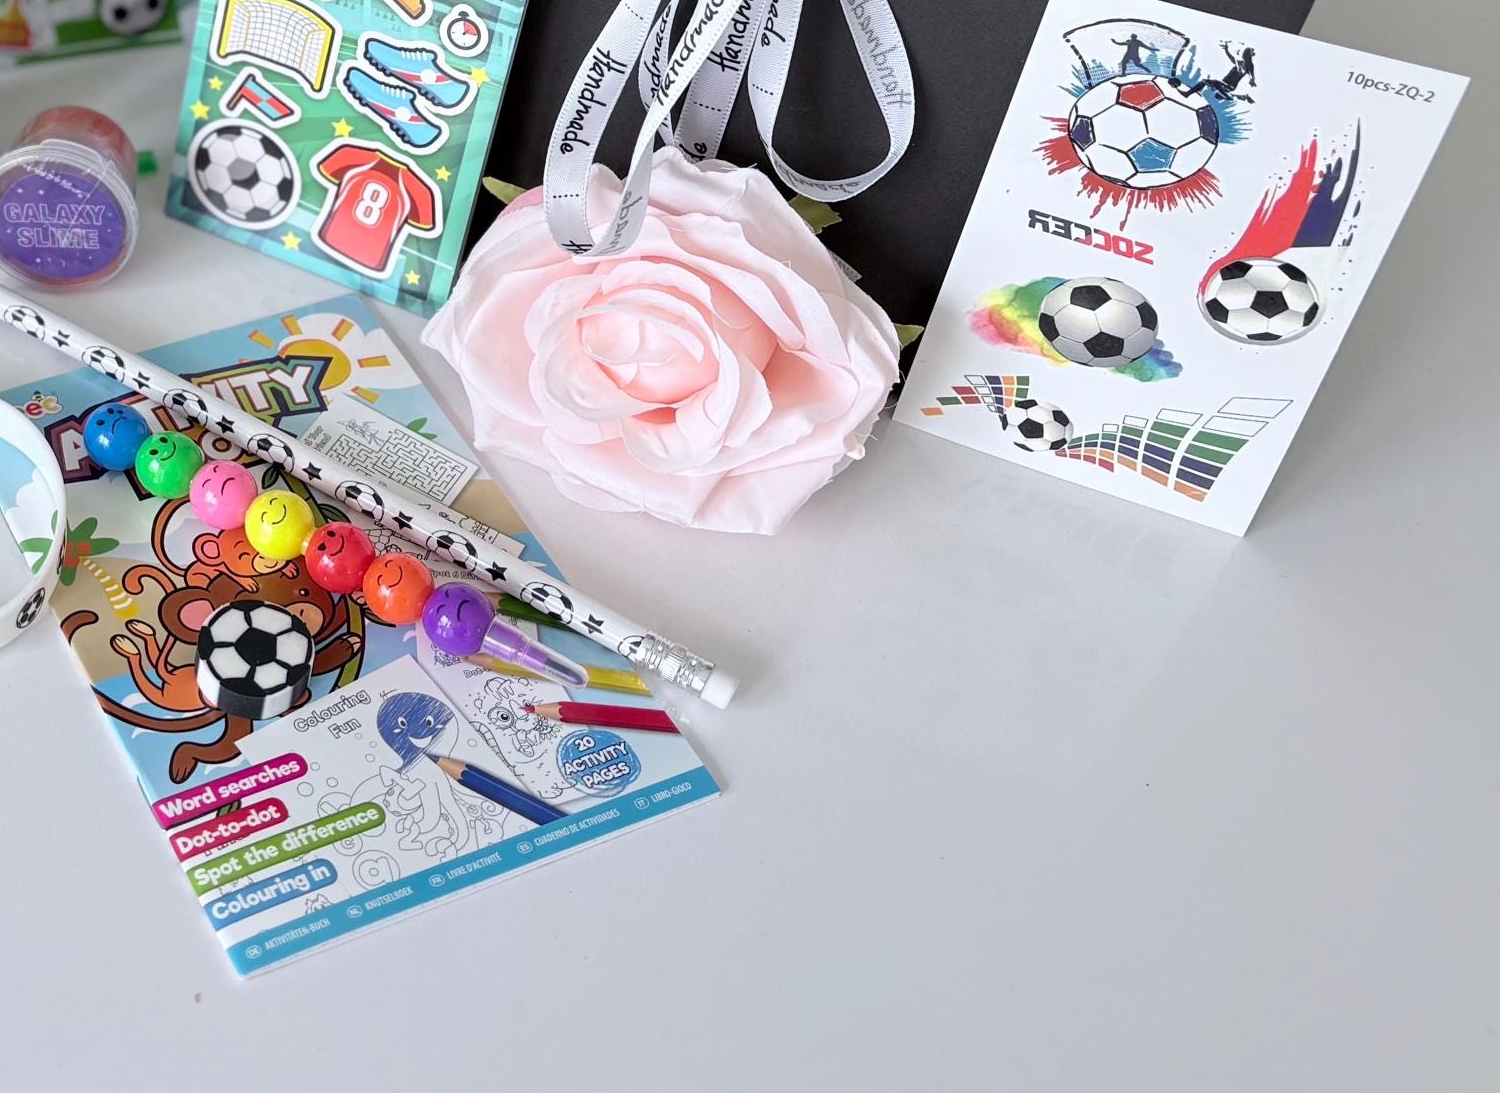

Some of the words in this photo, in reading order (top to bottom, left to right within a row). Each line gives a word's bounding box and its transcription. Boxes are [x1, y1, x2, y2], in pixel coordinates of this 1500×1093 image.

[560, 47, 628, 155] Handmade
[1346, 70, 1436, 104] 10pcs-ZQ-2
[3, 202, 106, 225] GALAXY
[353, 180, 389, 227] 8
[16, 227, 100, 249] SLIME
[293, 689, 372, 732] Colouring
[327, 718, 362, 739] Fun
[563, 741, 629, 776] ACTIVITY
[574, 734, 596, 752] 20
[158, 790, 217, 819] Word
[219, 760, 301, 799] searches
[581, 762, 631, 789] PAGES
[175, 804, 281, 855] Dot-to-dot
[193, 856, 243, 887] Spot
[243, 844, 280, 866] the
[281, 808, 380, 853] difference
[263, 917, 331, 951] AKTIVITÄTEN-BUCH
[364, 886, 414, 911] KNUTSELBOEK
[446, 863, 468, 881] LIVRE
[534, 826, 570, 847] CUADERNO
[568, 822, 580, 834] DE
[578, 809, 621, 831] ACTIVIDADES
[650, 781, 692, 804] LIBRO-GIOCO
[210, 872, 310, 921] Colouring
[310, 863, 331, 882] in
